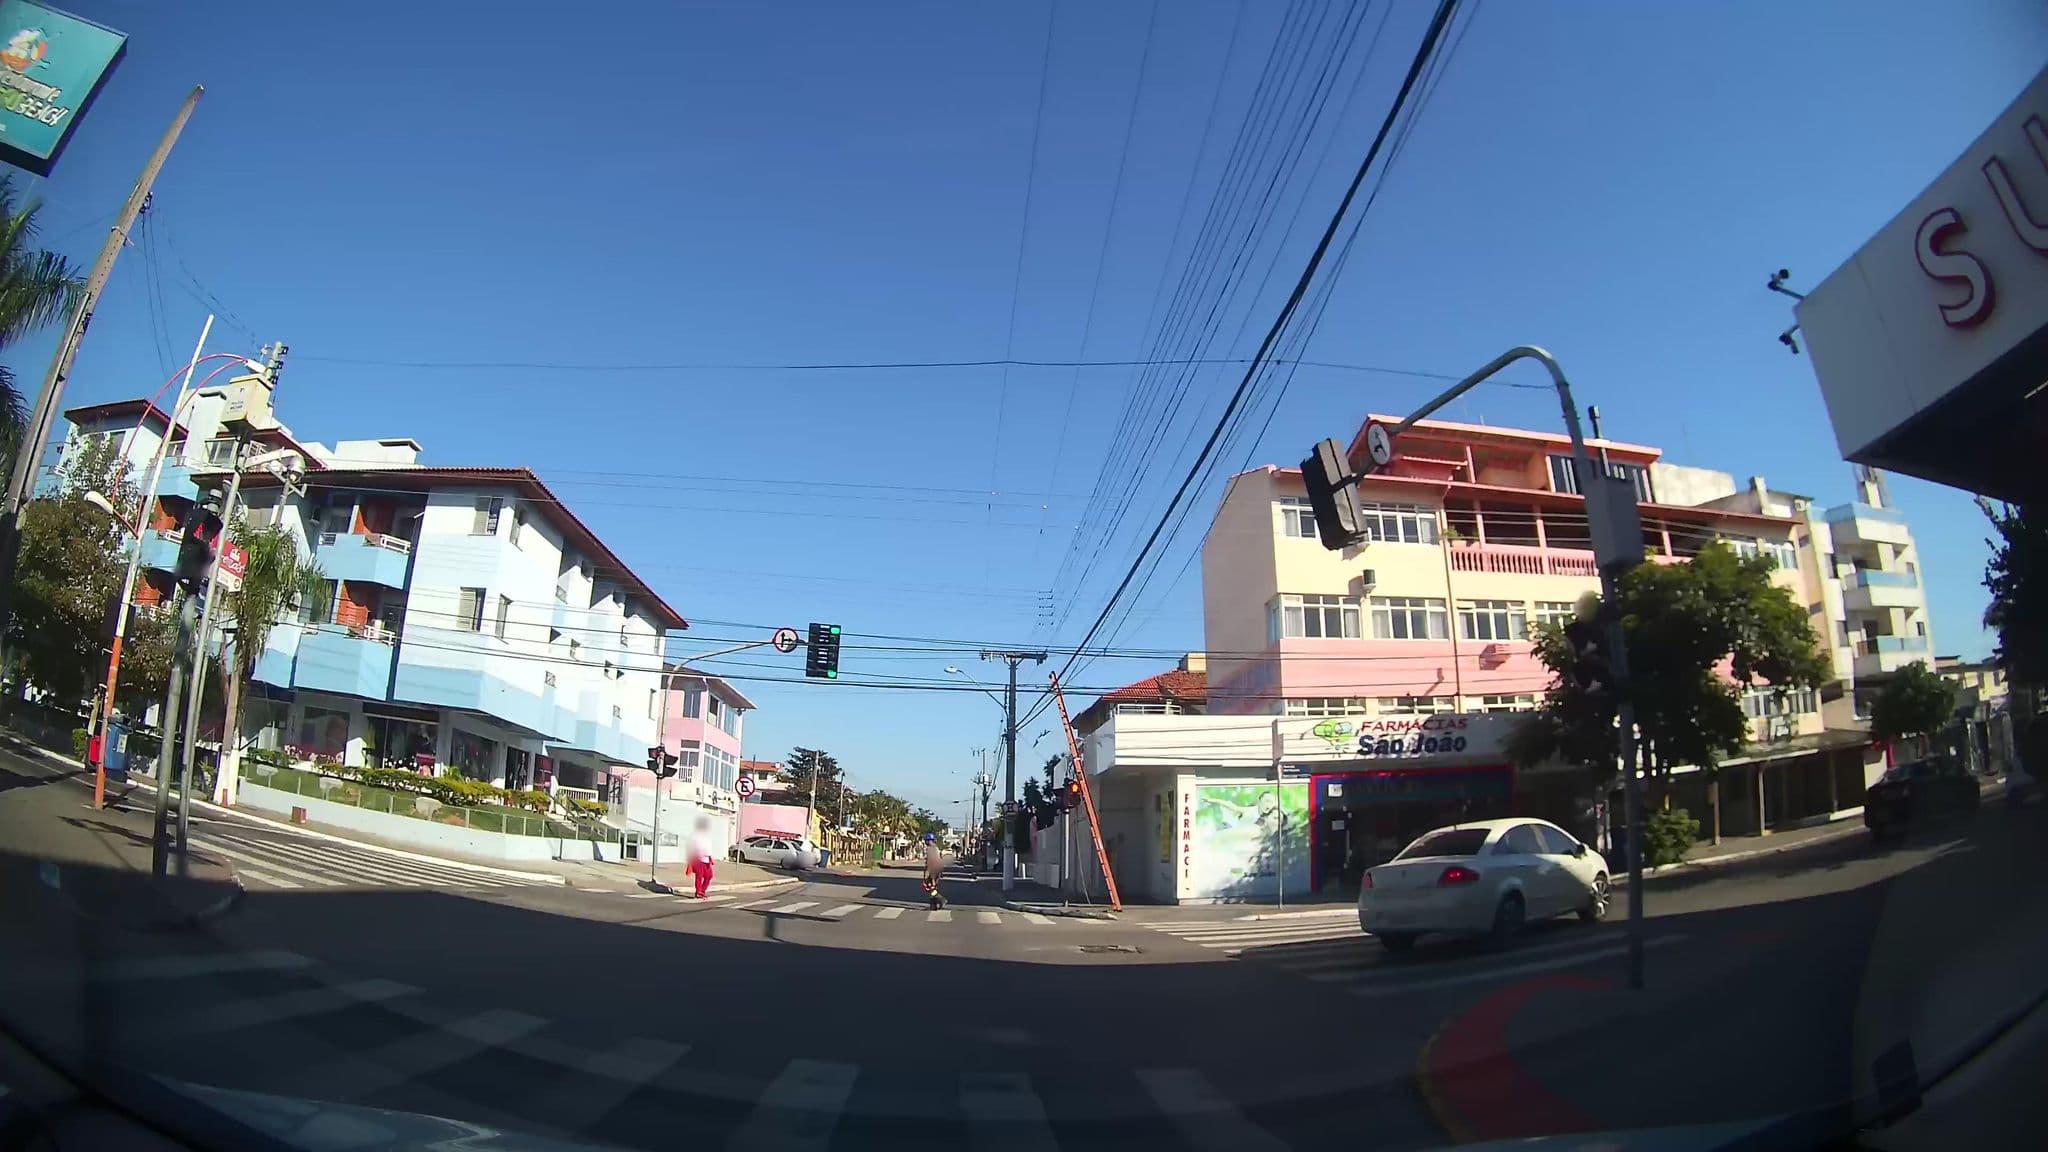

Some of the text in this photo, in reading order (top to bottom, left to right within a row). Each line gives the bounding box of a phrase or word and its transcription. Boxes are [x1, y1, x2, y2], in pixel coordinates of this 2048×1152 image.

[1358, 732, 1467, 755] São João
[1182, 793, 1192, 891] FARMACI
